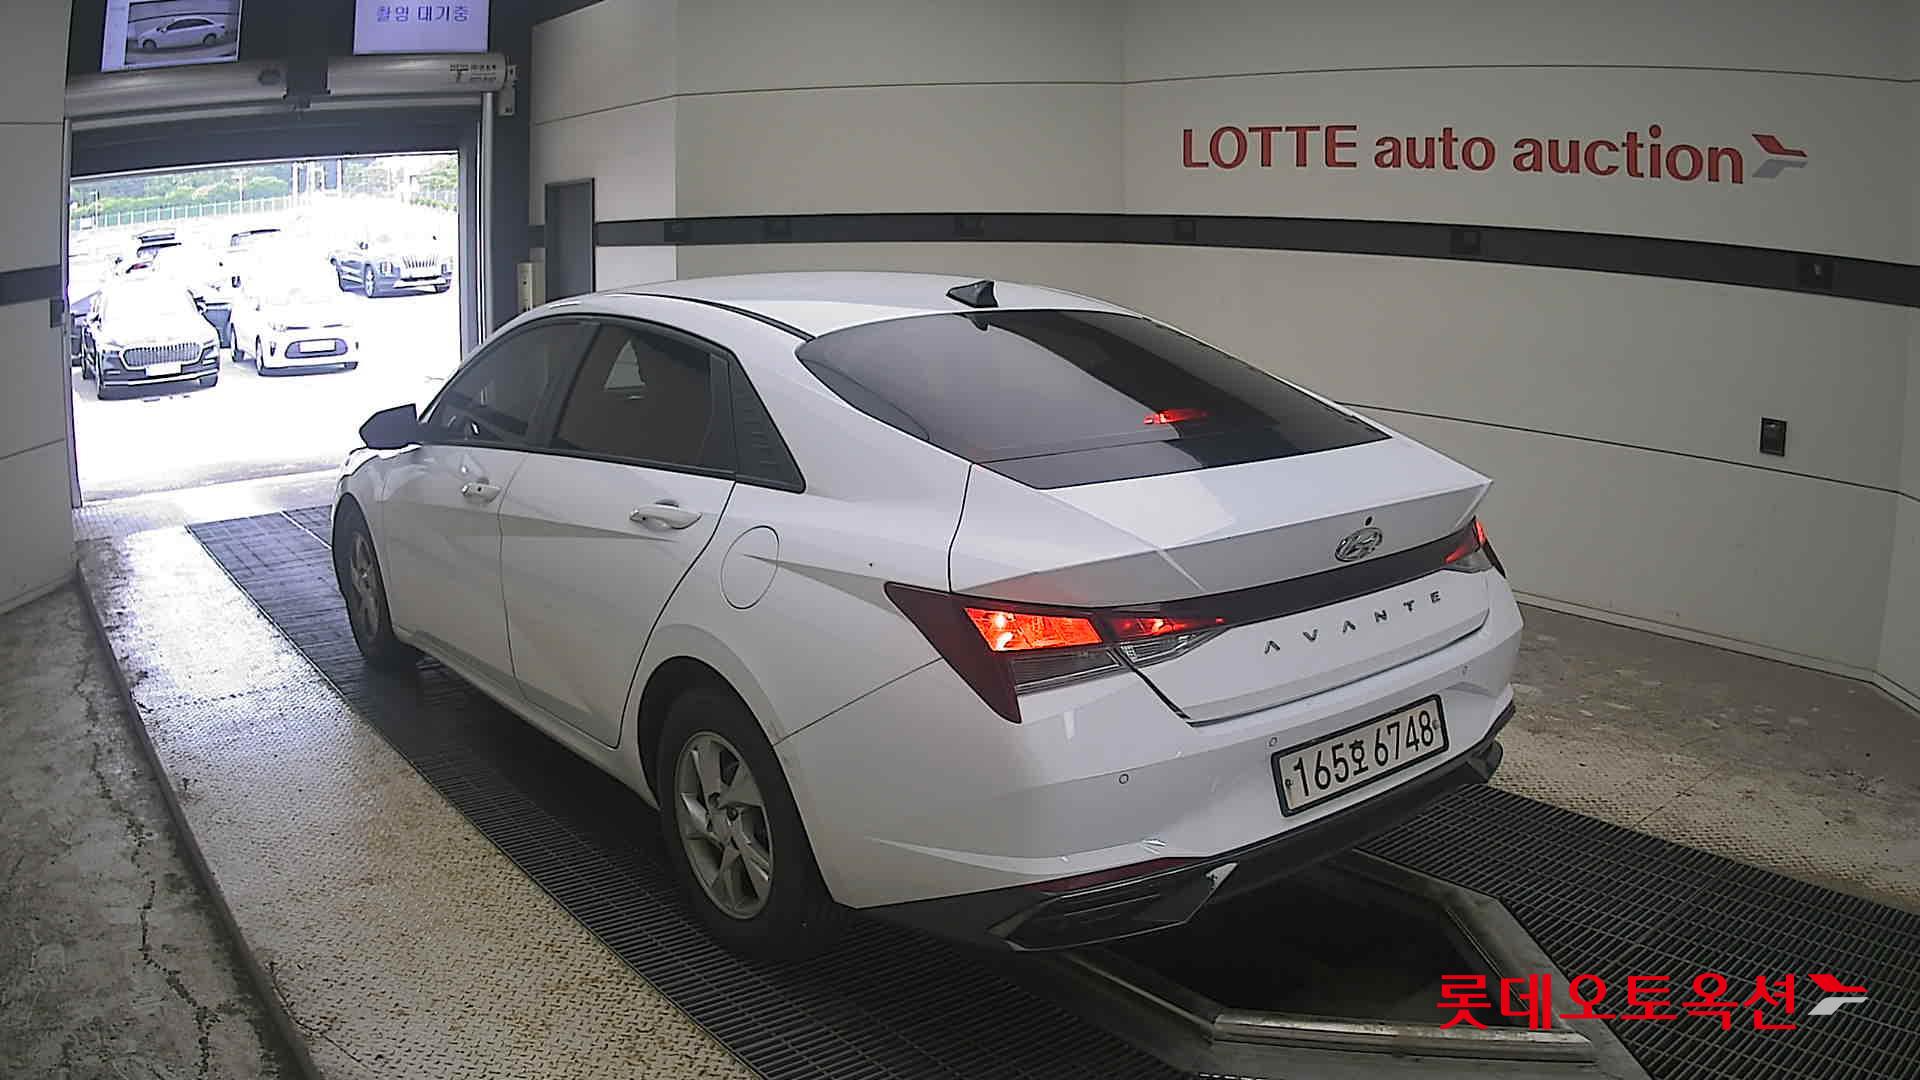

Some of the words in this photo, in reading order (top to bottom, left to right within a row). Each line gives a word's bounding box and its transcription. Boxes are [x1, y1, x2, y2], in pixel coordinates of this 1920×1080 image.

[418, 6, 469, 22] 대기중
[1183, 125, 1357, 169] LOTTE
[1375, 127, 1495, 171] auto
[1514, 124, 1743, 185] auction
[1264, 591, 1441, 655] AVANTE
